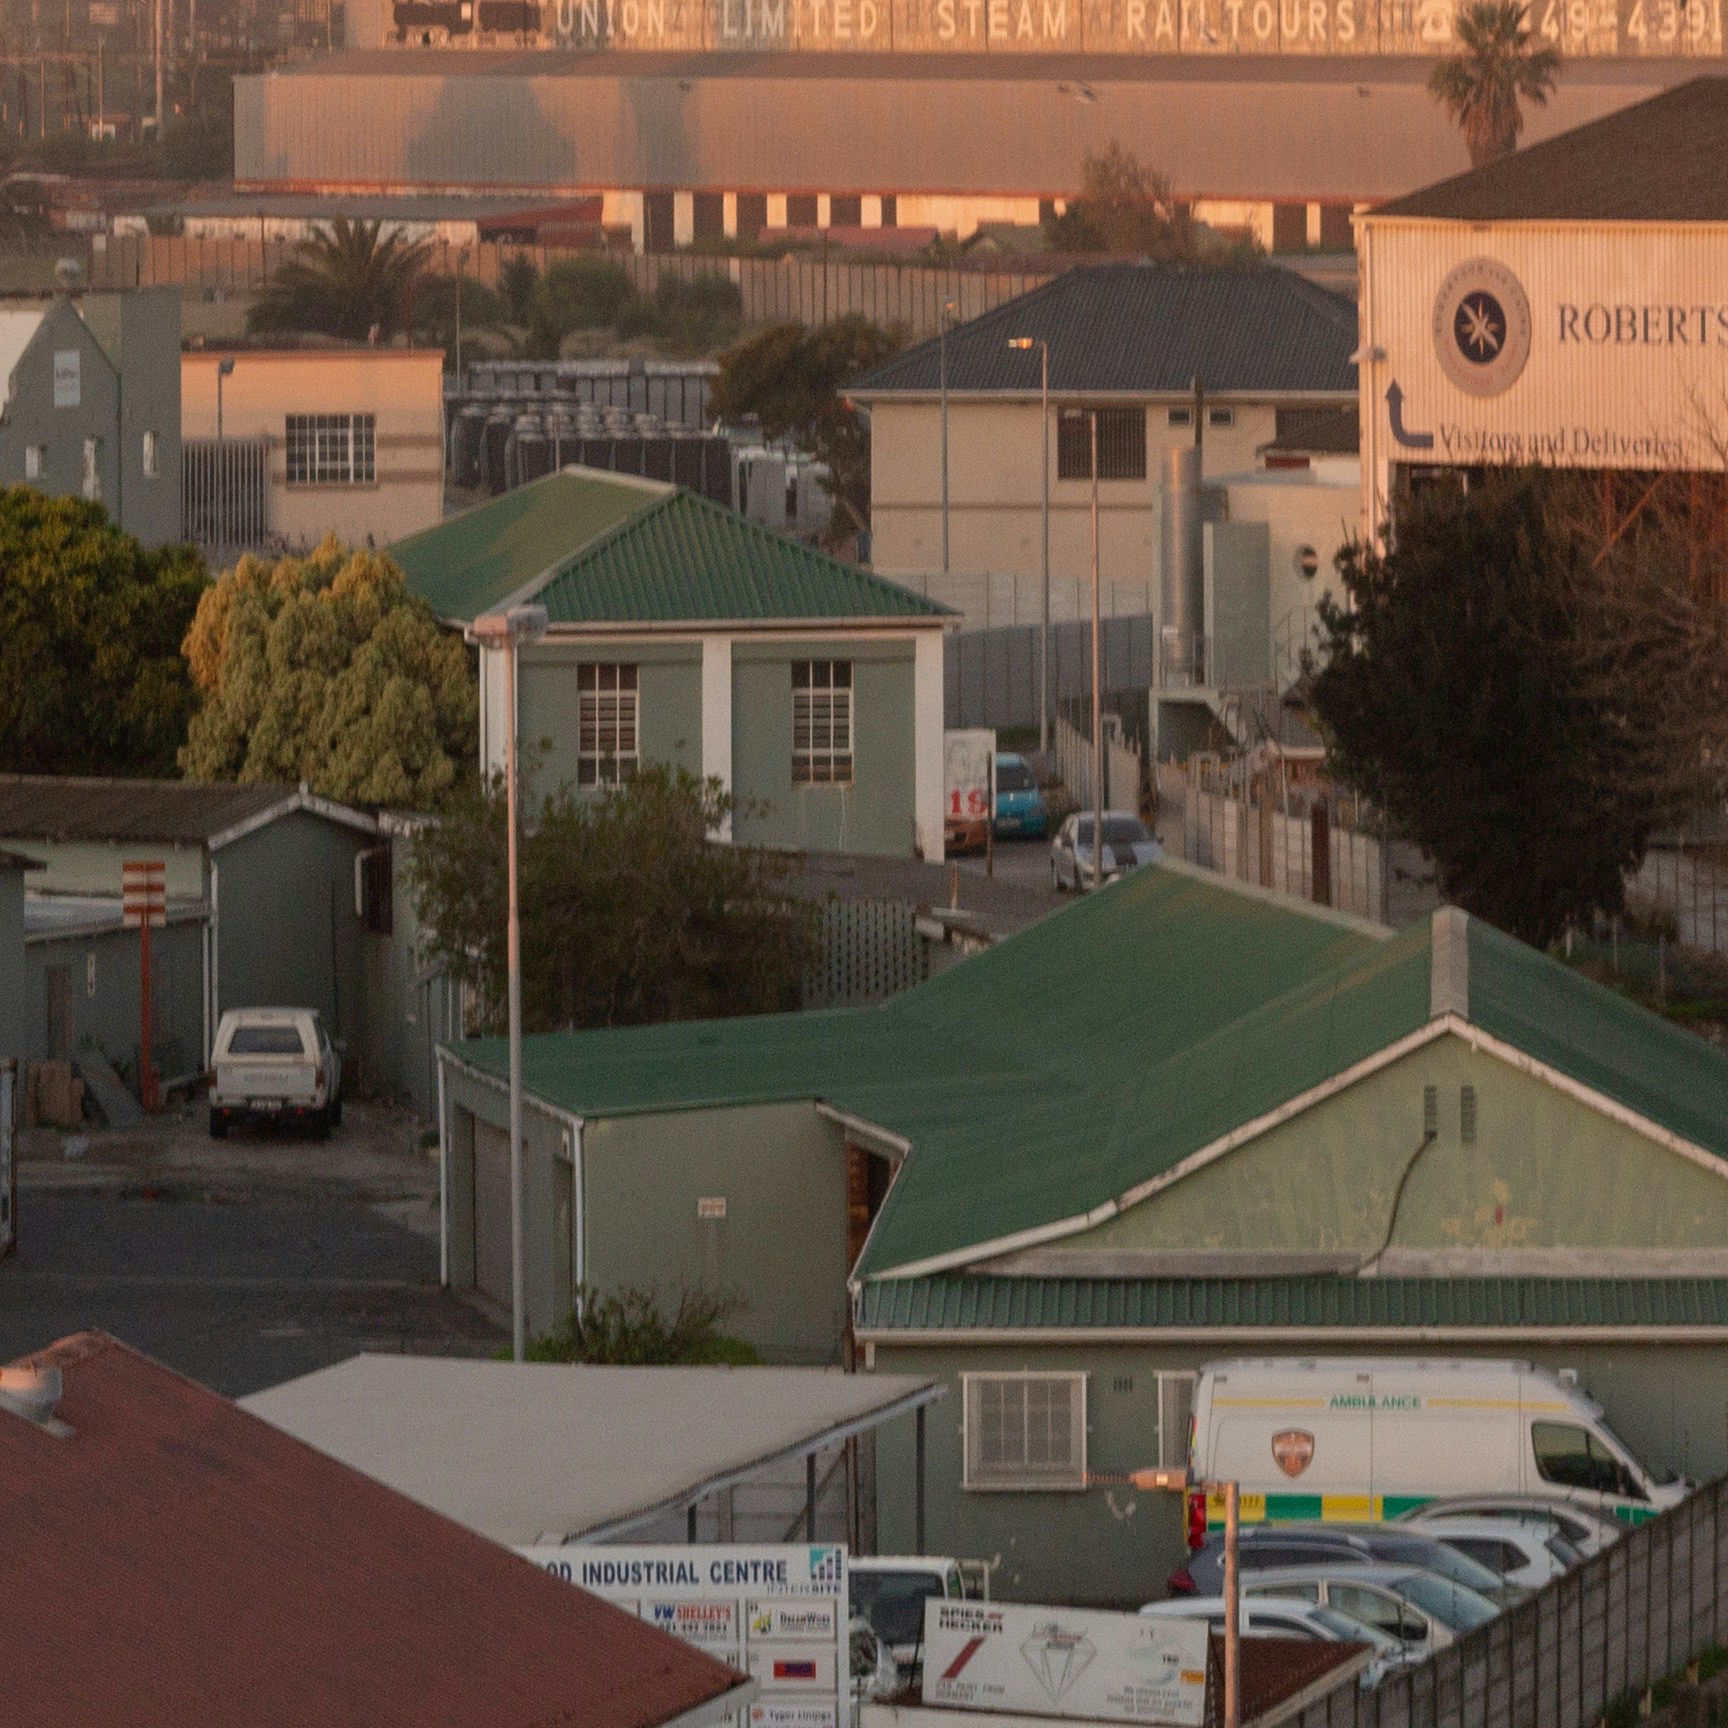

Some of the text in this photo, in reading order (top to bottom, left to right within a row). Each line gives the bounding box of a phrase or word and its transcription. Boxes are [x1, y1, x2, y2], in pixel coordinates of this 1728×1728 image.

[1328, 1393, 1422, 1410] AMBULANCE
[581, 1560, 700, 1586] INDUSTRIAL
[709, 1559, 788, 1585] CENTRE
